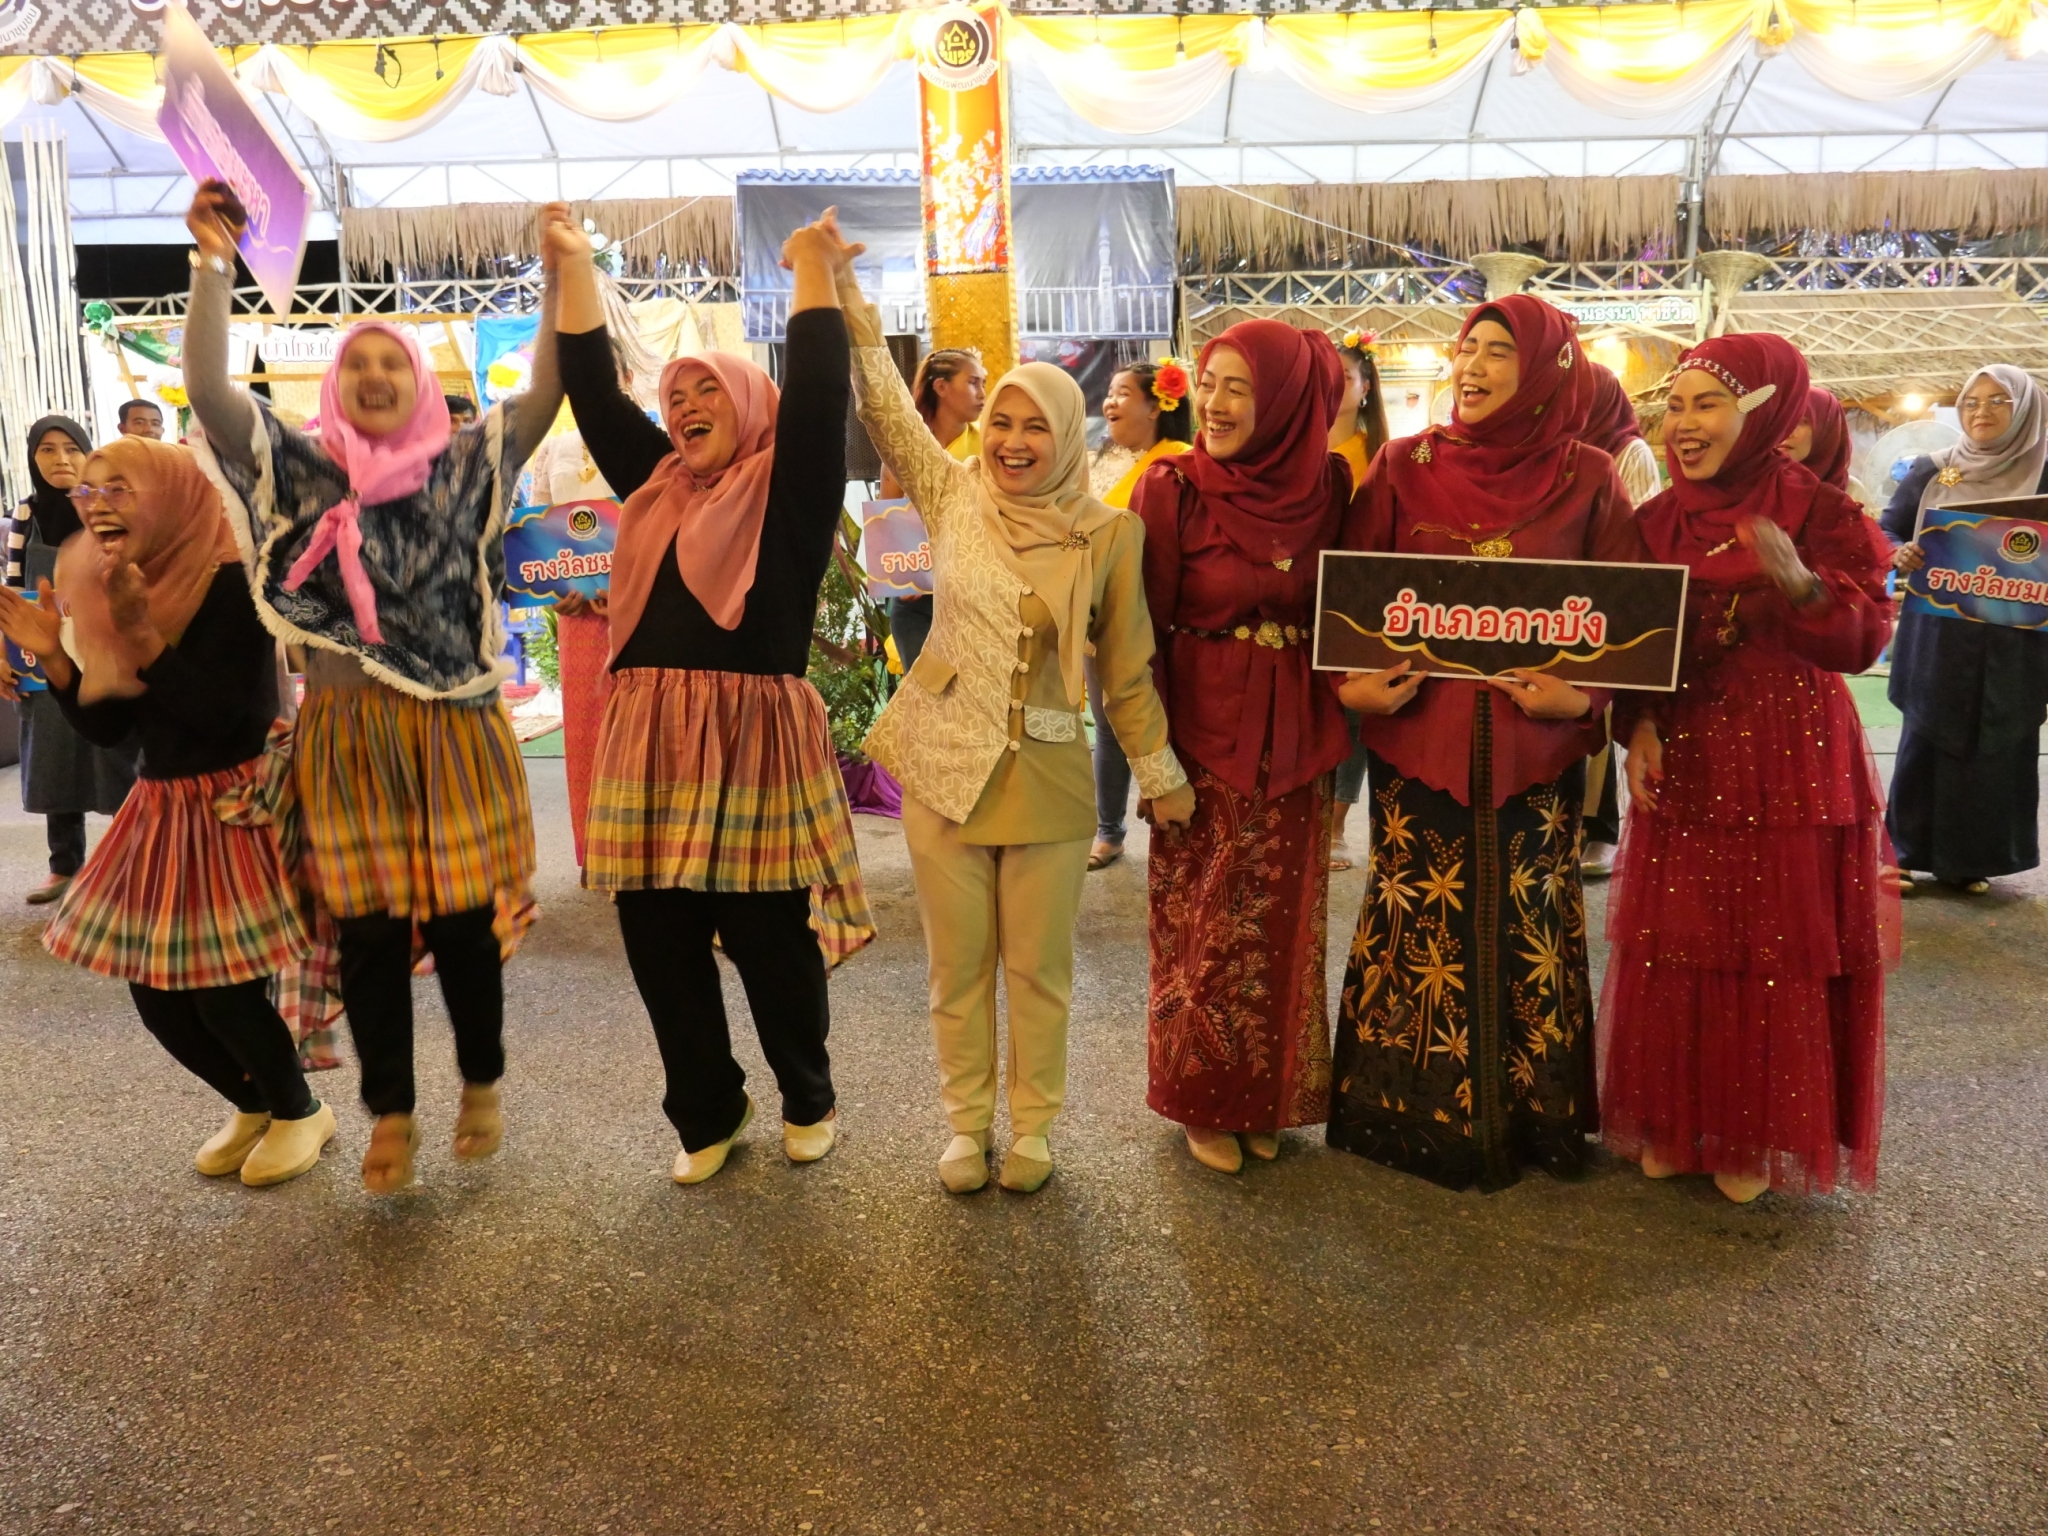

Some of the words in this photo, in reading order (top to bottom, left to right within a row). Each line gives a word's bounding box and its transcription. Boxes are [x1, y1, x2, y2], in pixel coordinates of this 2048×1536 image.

[0, 6, 38, 43] นาชุมชน
[1561, 306, 1636, 322] หนองนา
[1638, 301, 1694, 322] พาชีวิต
[1384, 588, 1607, 647] อำเภอกาบัง
